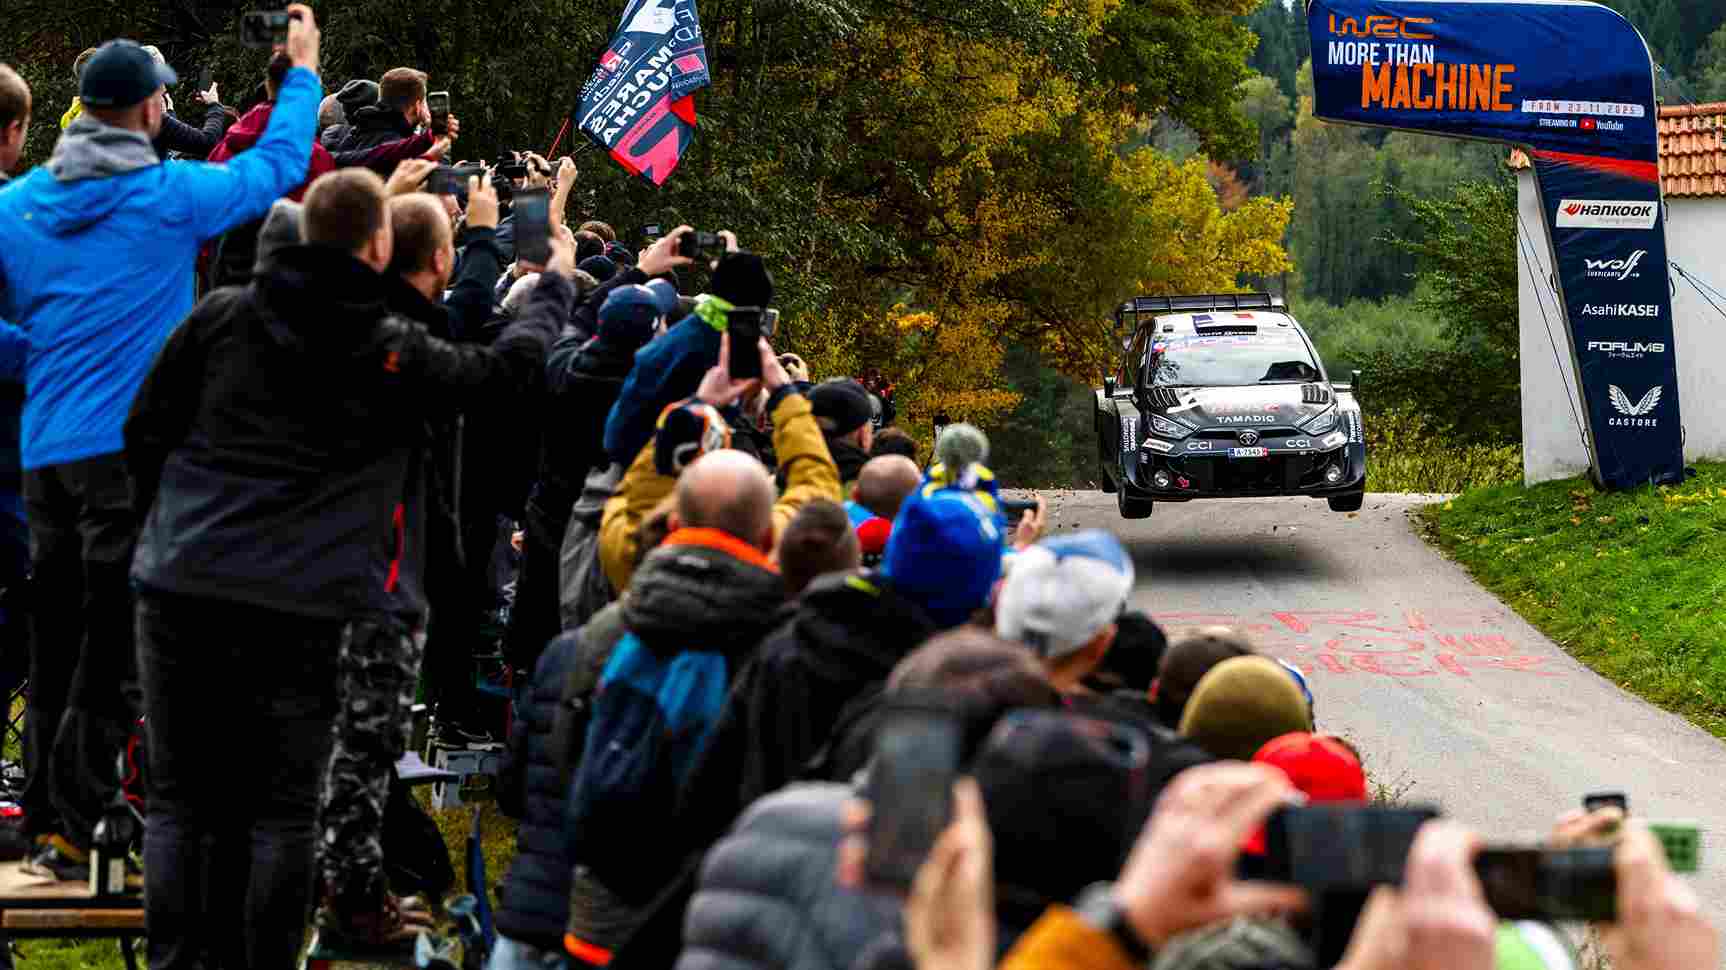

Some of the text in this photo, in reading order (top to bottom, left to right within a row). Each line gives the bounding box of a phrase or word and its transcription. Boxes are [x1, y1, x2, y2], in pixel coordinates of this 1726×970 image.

[1328, 14, 1436, 39] WRC
[1328, 41, 1434, 66] MORE THAN
[1361, 62, 1516, 112] MACHINE
[1569, 119, 1577, 128] ON
[1596, 120, 1624, 130] YouTube
[1608, 417, 1657, 427] CASTORE
[1187, 441, 1213, 450] CCI
[1286, 439, 1311, 448] CCI
